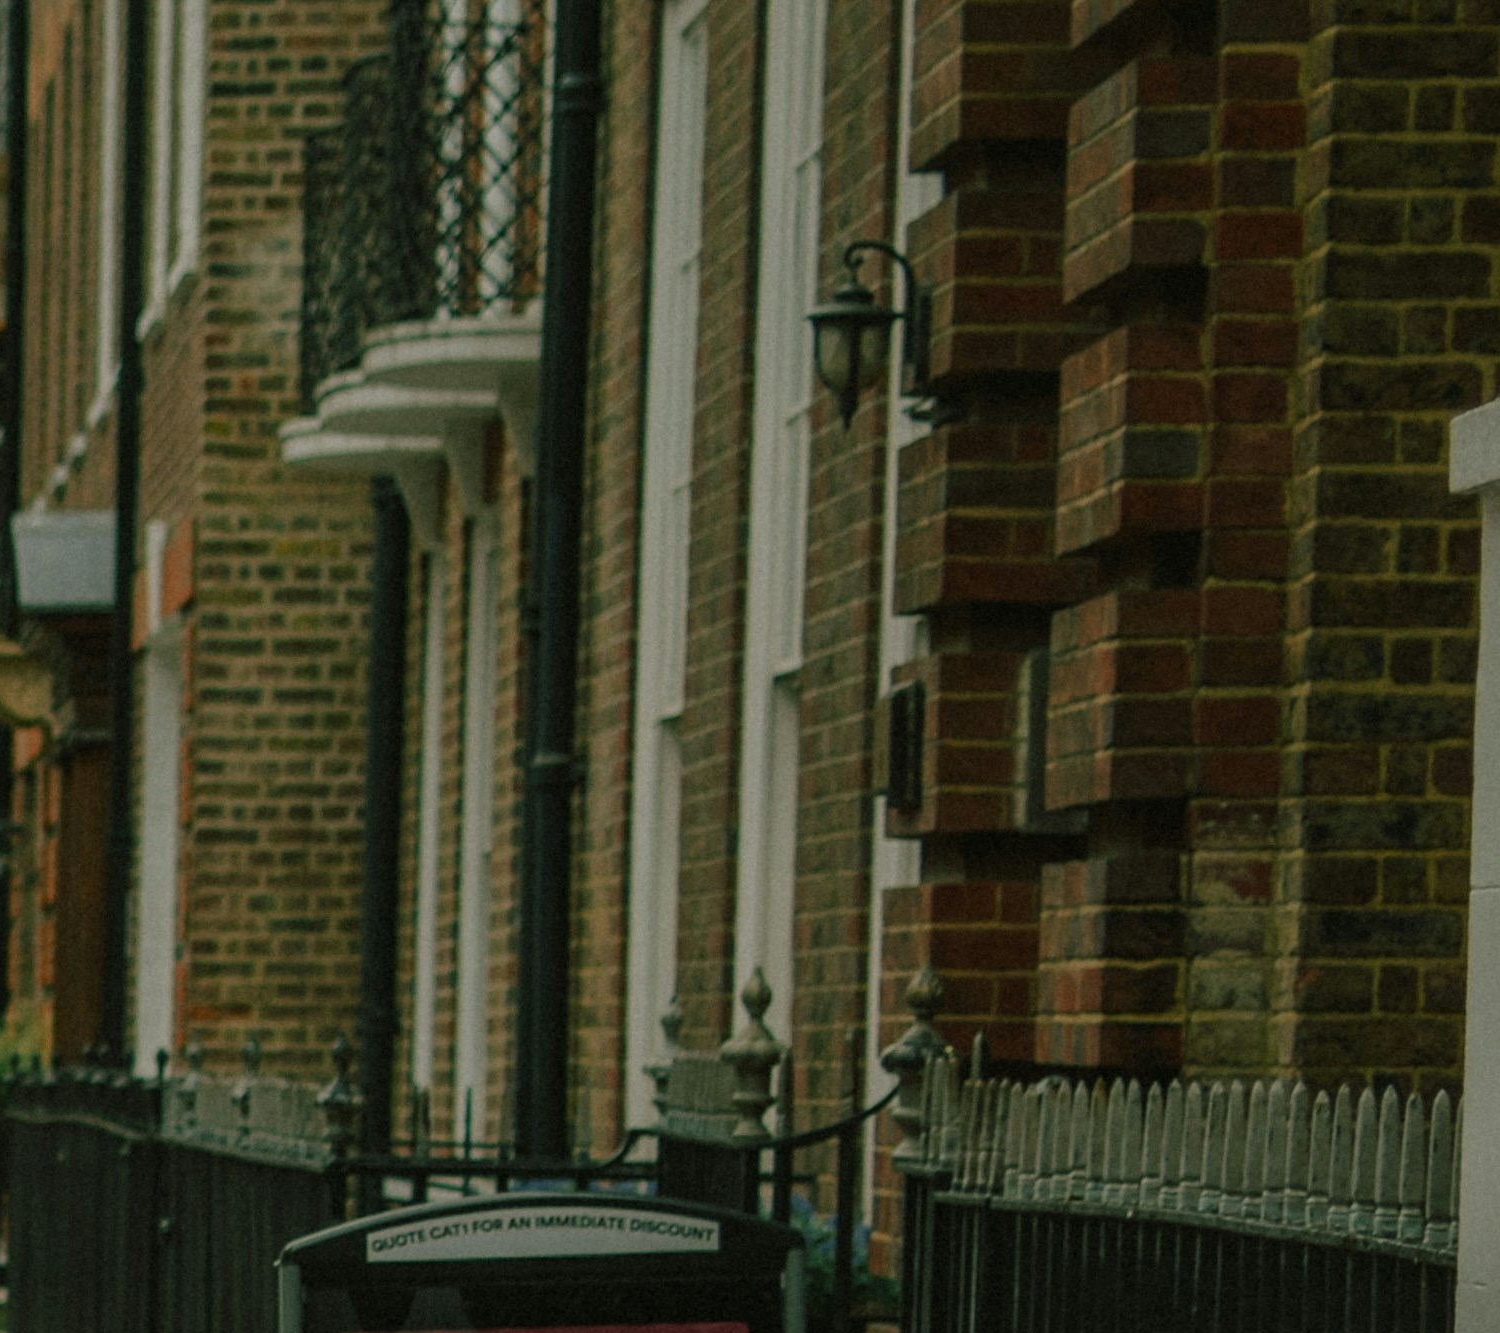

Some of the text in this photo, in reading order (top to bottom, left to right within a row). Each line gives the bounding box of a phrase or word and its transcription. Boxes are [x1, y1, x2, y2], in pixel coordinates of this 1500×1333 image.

[372, 1229, 427, 1252] QUOTE
[472, 1218, 503, 1233] FOR
[508, 1217, 531, 1230] AN
[536, 1215, 626, 1230] IMMEDIATE
[630, 1218, 715, 1242] DISCOUNT
